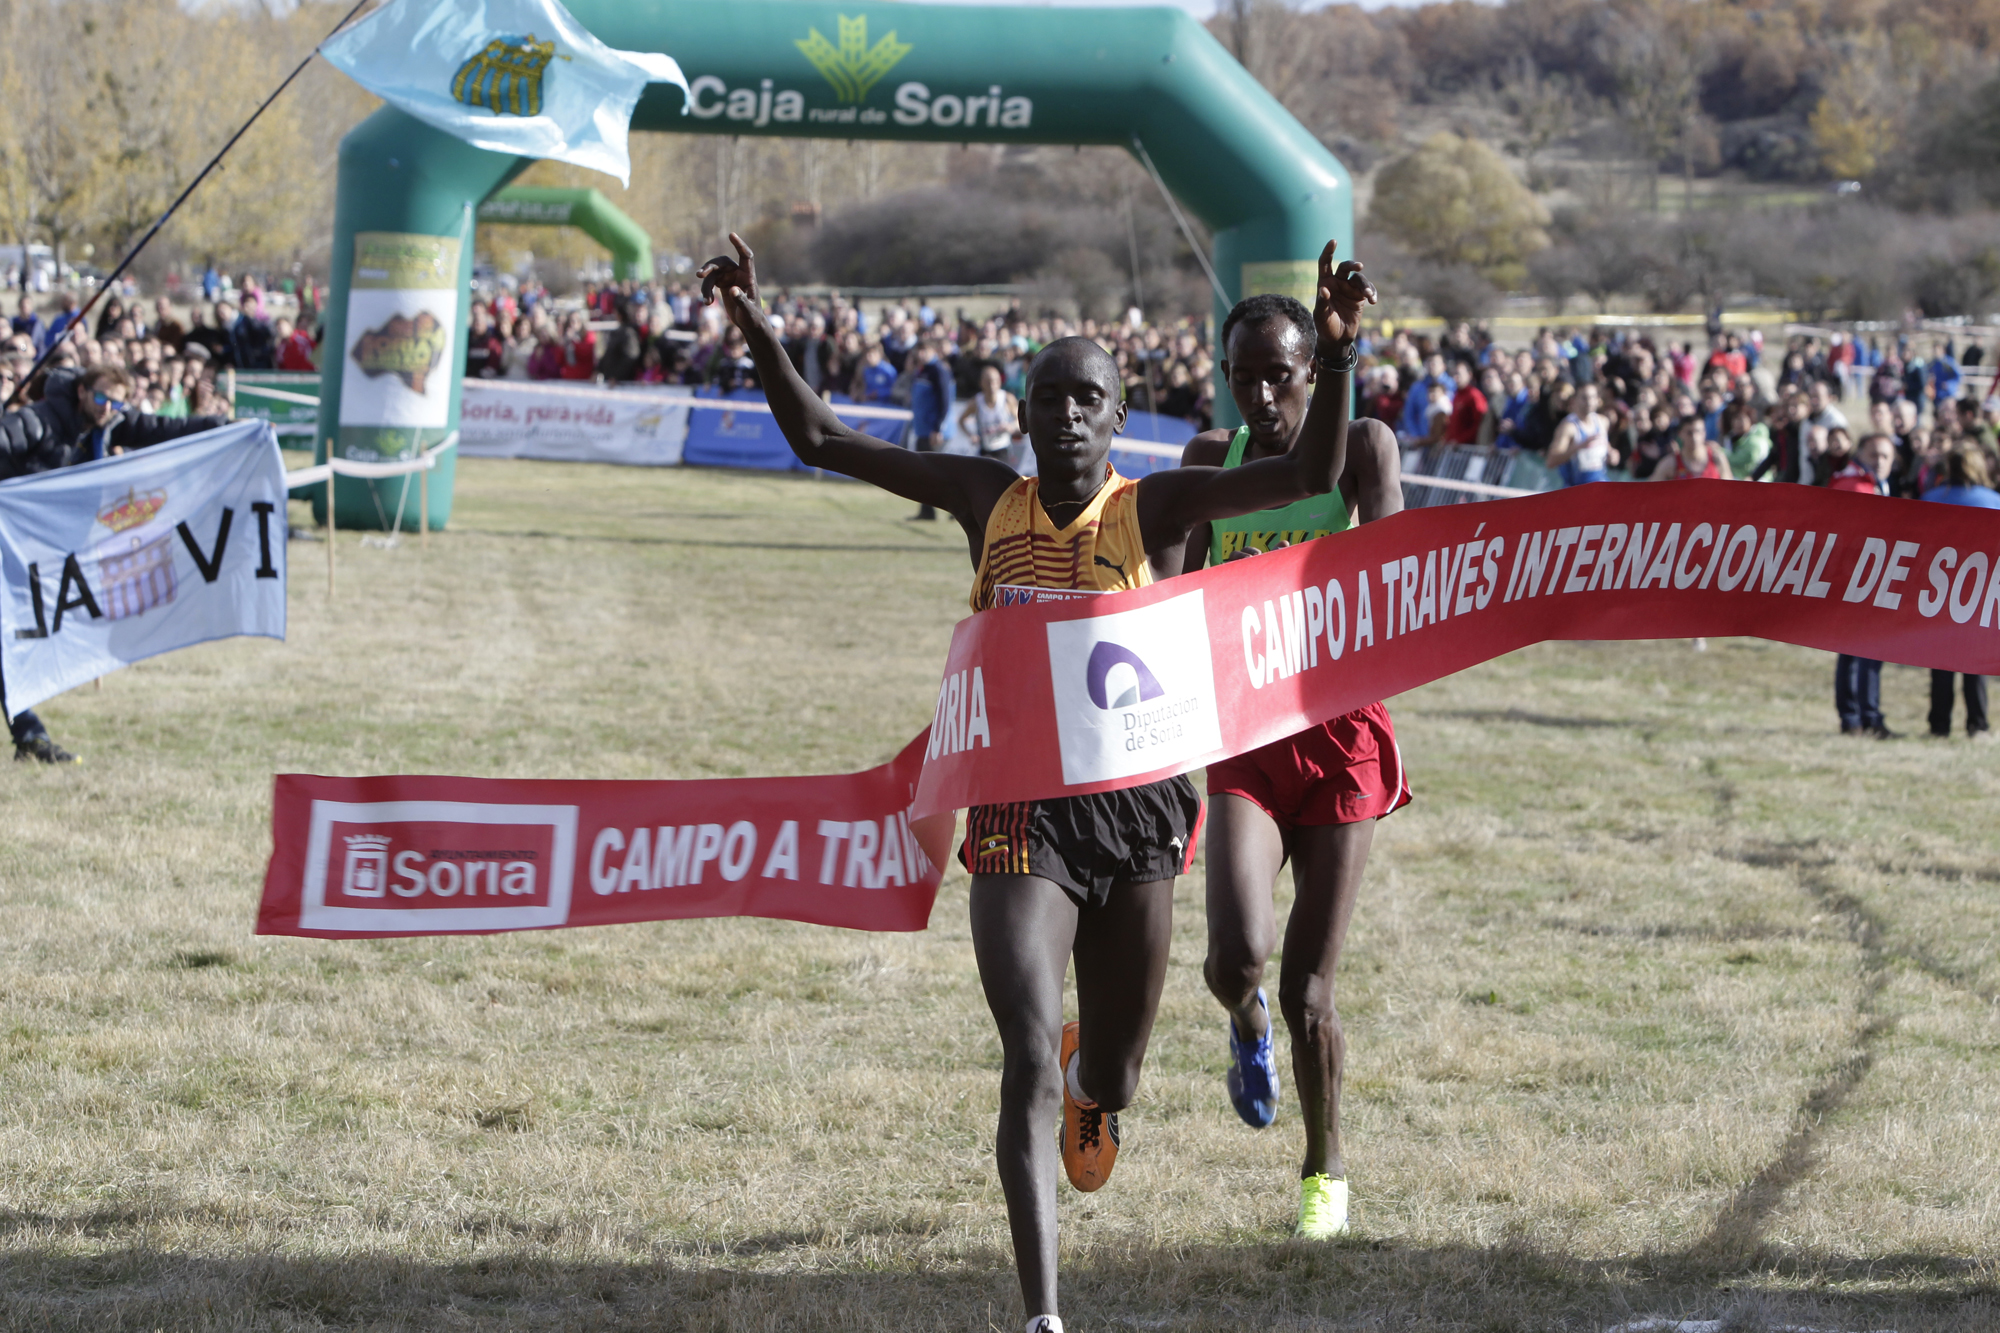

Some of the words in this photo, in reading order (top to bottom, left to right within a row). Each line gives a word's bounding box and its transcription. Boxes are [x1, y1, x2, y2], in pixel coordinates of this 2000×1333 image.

[689, 75, 805, 126] Caja
[810, 108, 857, 123] rural
[860, 108, 886, 124] de
[893, 82, 1033, 127] Soria
[1241, 578, 1346, 690] CAMPO
[1354, 570, 1374, 652] A
[1381, 522, 1504, 636] TRAVÉS
[1503, 521, 1838, 603] INTERNACIONAL
[1842, 536, 1920, 611] DE
[923, 666, 991, 765] ORIA
[1125, 731, 1146, 752] de
[1149, 721, 1183, 746] Soria
[389, 850, 537, 898] Soria
[589, 819, 758, 896] CAMPO
[760, 819, 799, 881] A
